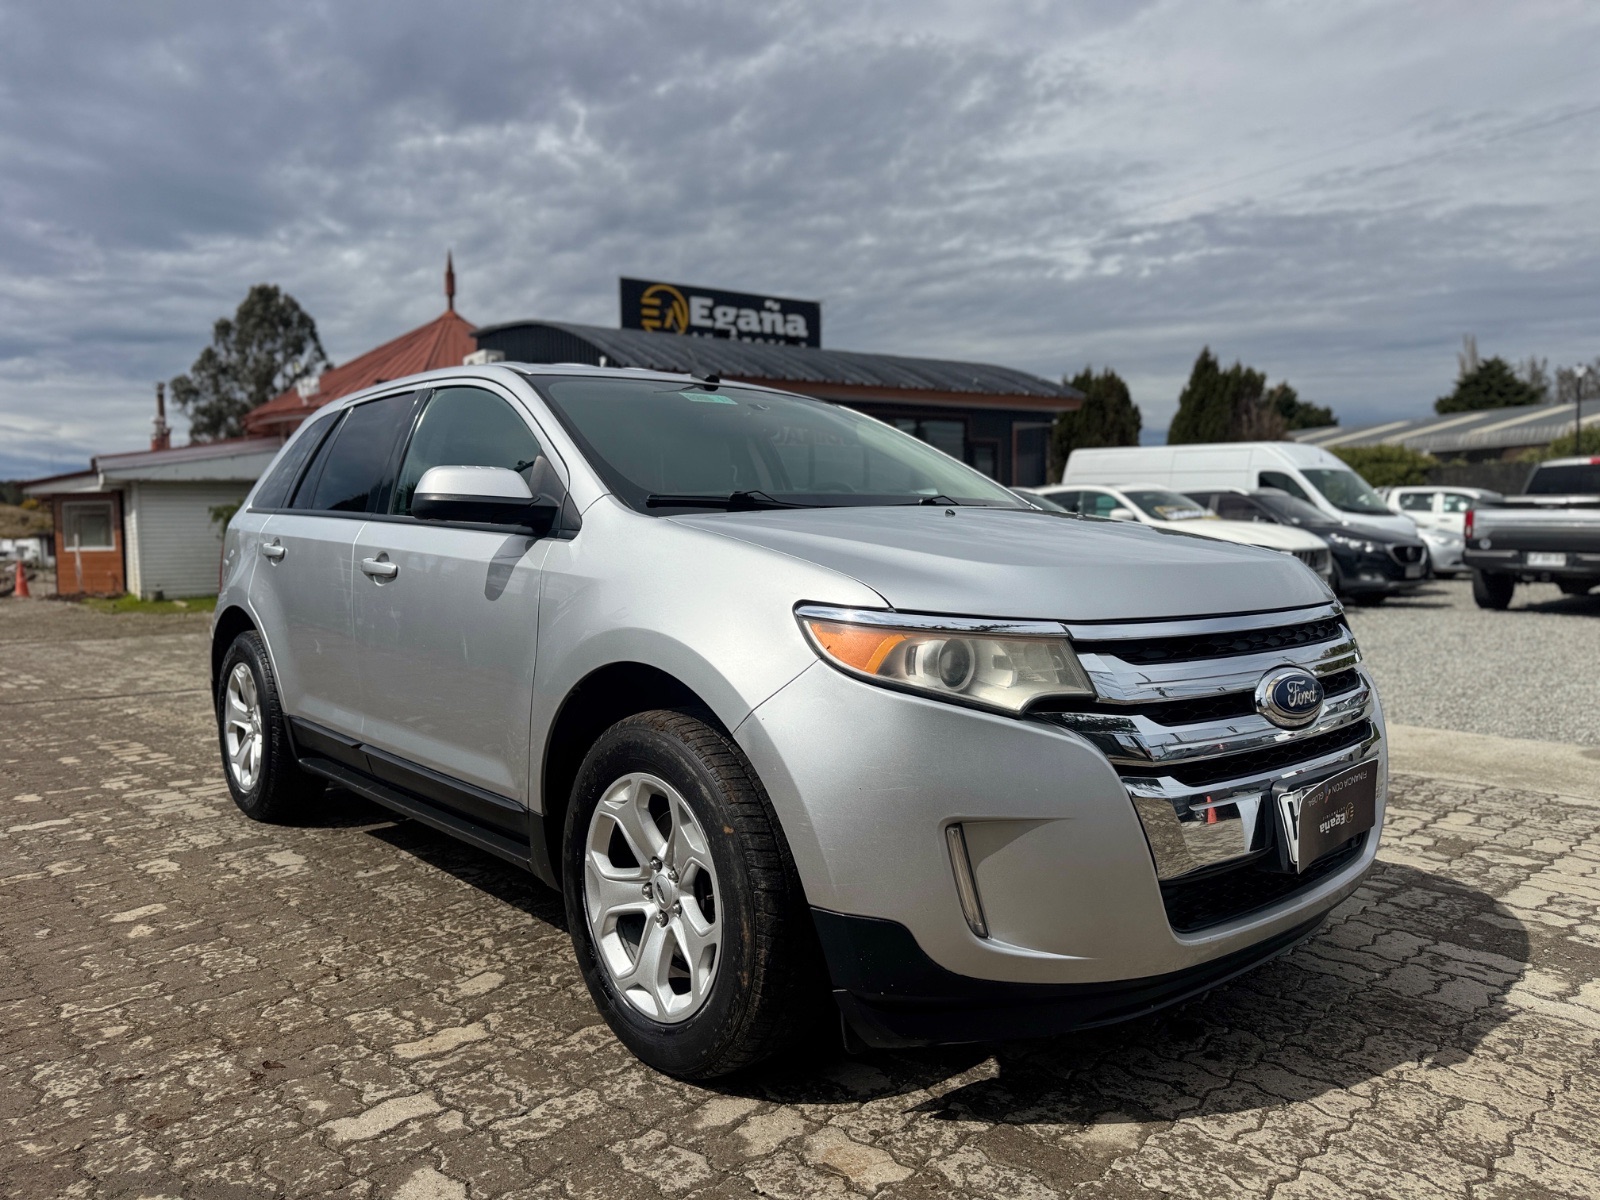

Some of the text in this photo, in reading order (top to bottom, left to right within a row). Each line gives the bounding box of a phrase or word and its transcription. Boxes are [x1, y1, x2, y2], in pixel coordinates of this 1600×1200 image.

[689, 297, 808, 340] Egaña
[1286, 680, 1317, 707] Ford
[1331, 781, 1344, 793] CON
[1319, 813, 1346, 833] Egaña
